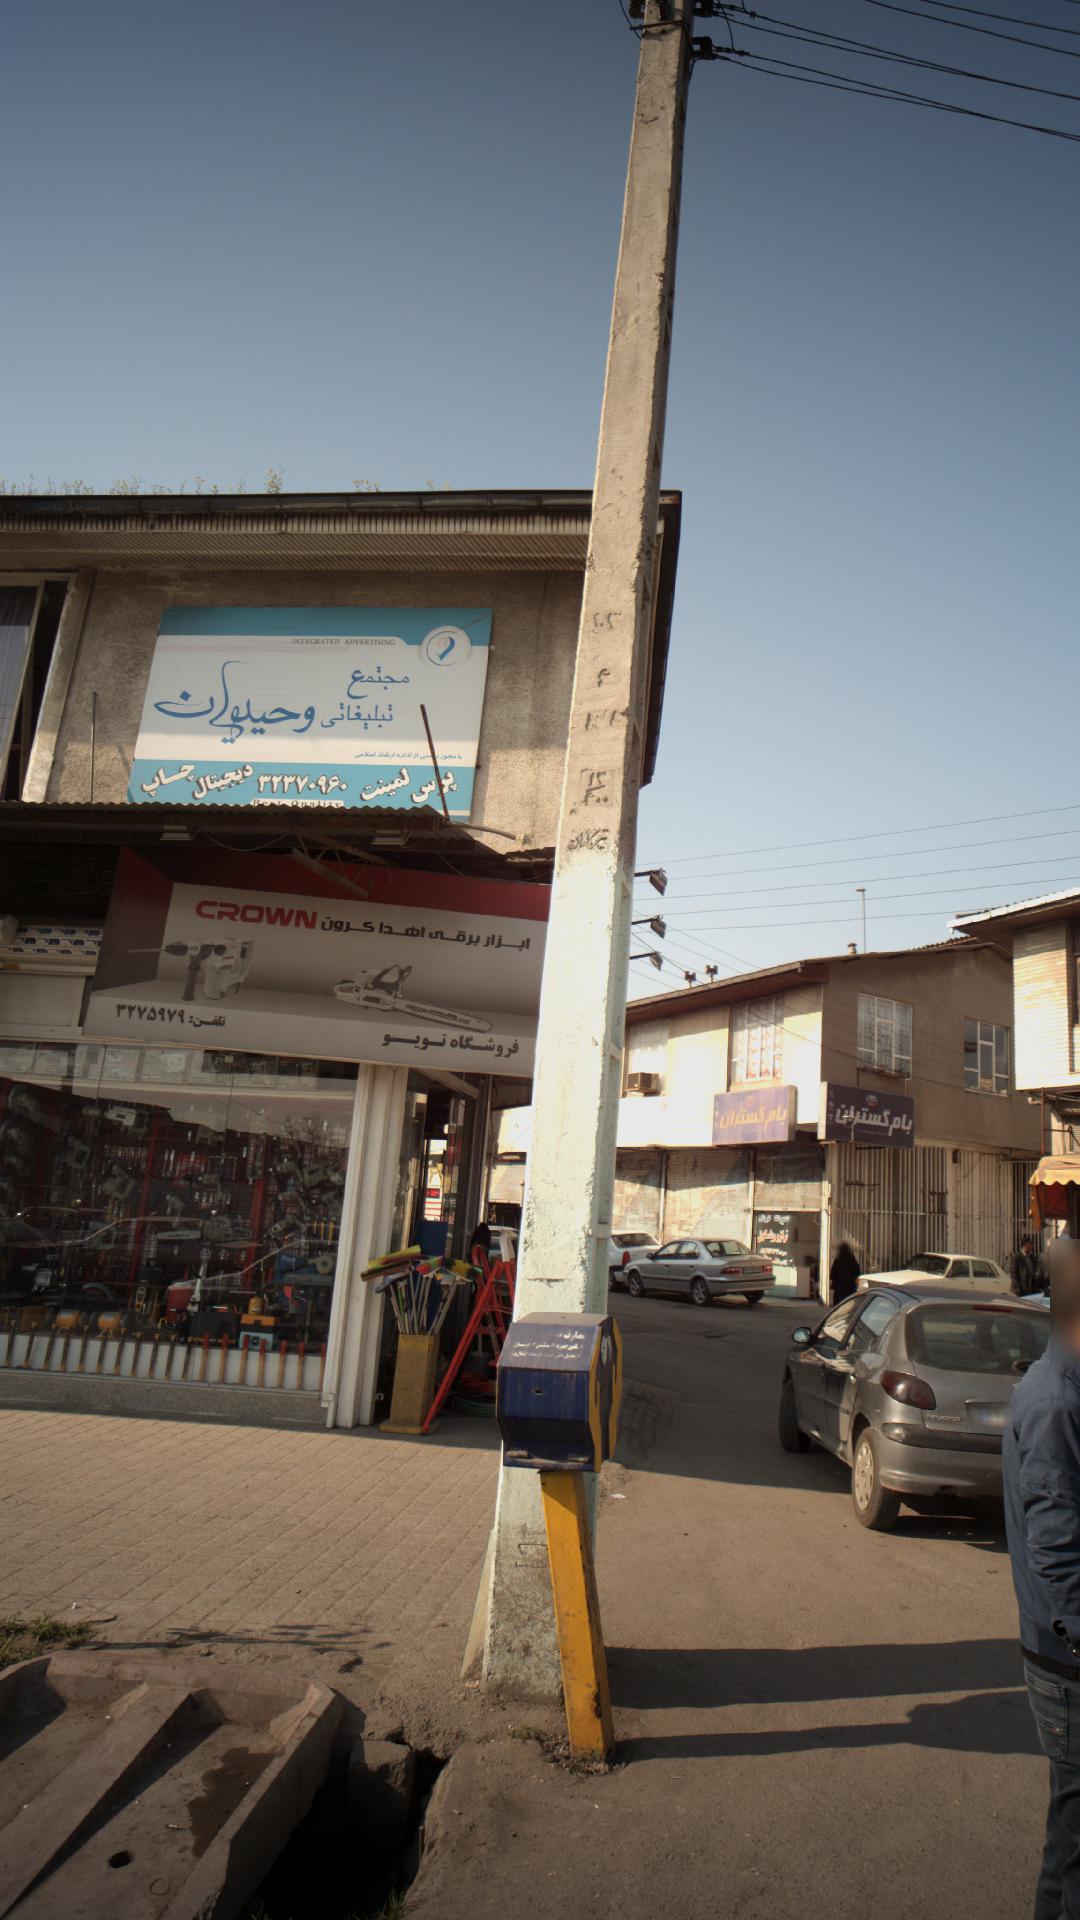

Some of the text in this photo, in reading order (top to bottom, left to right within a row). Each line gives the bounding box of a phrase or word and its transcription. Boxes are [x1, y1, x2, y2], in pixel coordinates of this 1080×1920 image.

[292, 638, 396, 646] INTEGRATED ADVERTISING
[347, 666, 410, 699] مجتمع
[320, 702, 393, 730] تبلیغاتی
[142, 764, 195, 797] چاپ
[193, 764, 254, 800] دیجیتال
[258, 774, 348, 794] ۳۲۳۷۰۹۶۰
[361, 767, 410, 801] لمینت
[195, 900, 318, 930] CROWN
[321, 916, 531, 951] ابزار برقی اهدا کرون
[116, 1003, 185, 1024] ۳۲۷۵۹۷۹
[382, 1033, 520, 1058] فروشگاه تویو
[887, 1114, 913, 1137] بام
